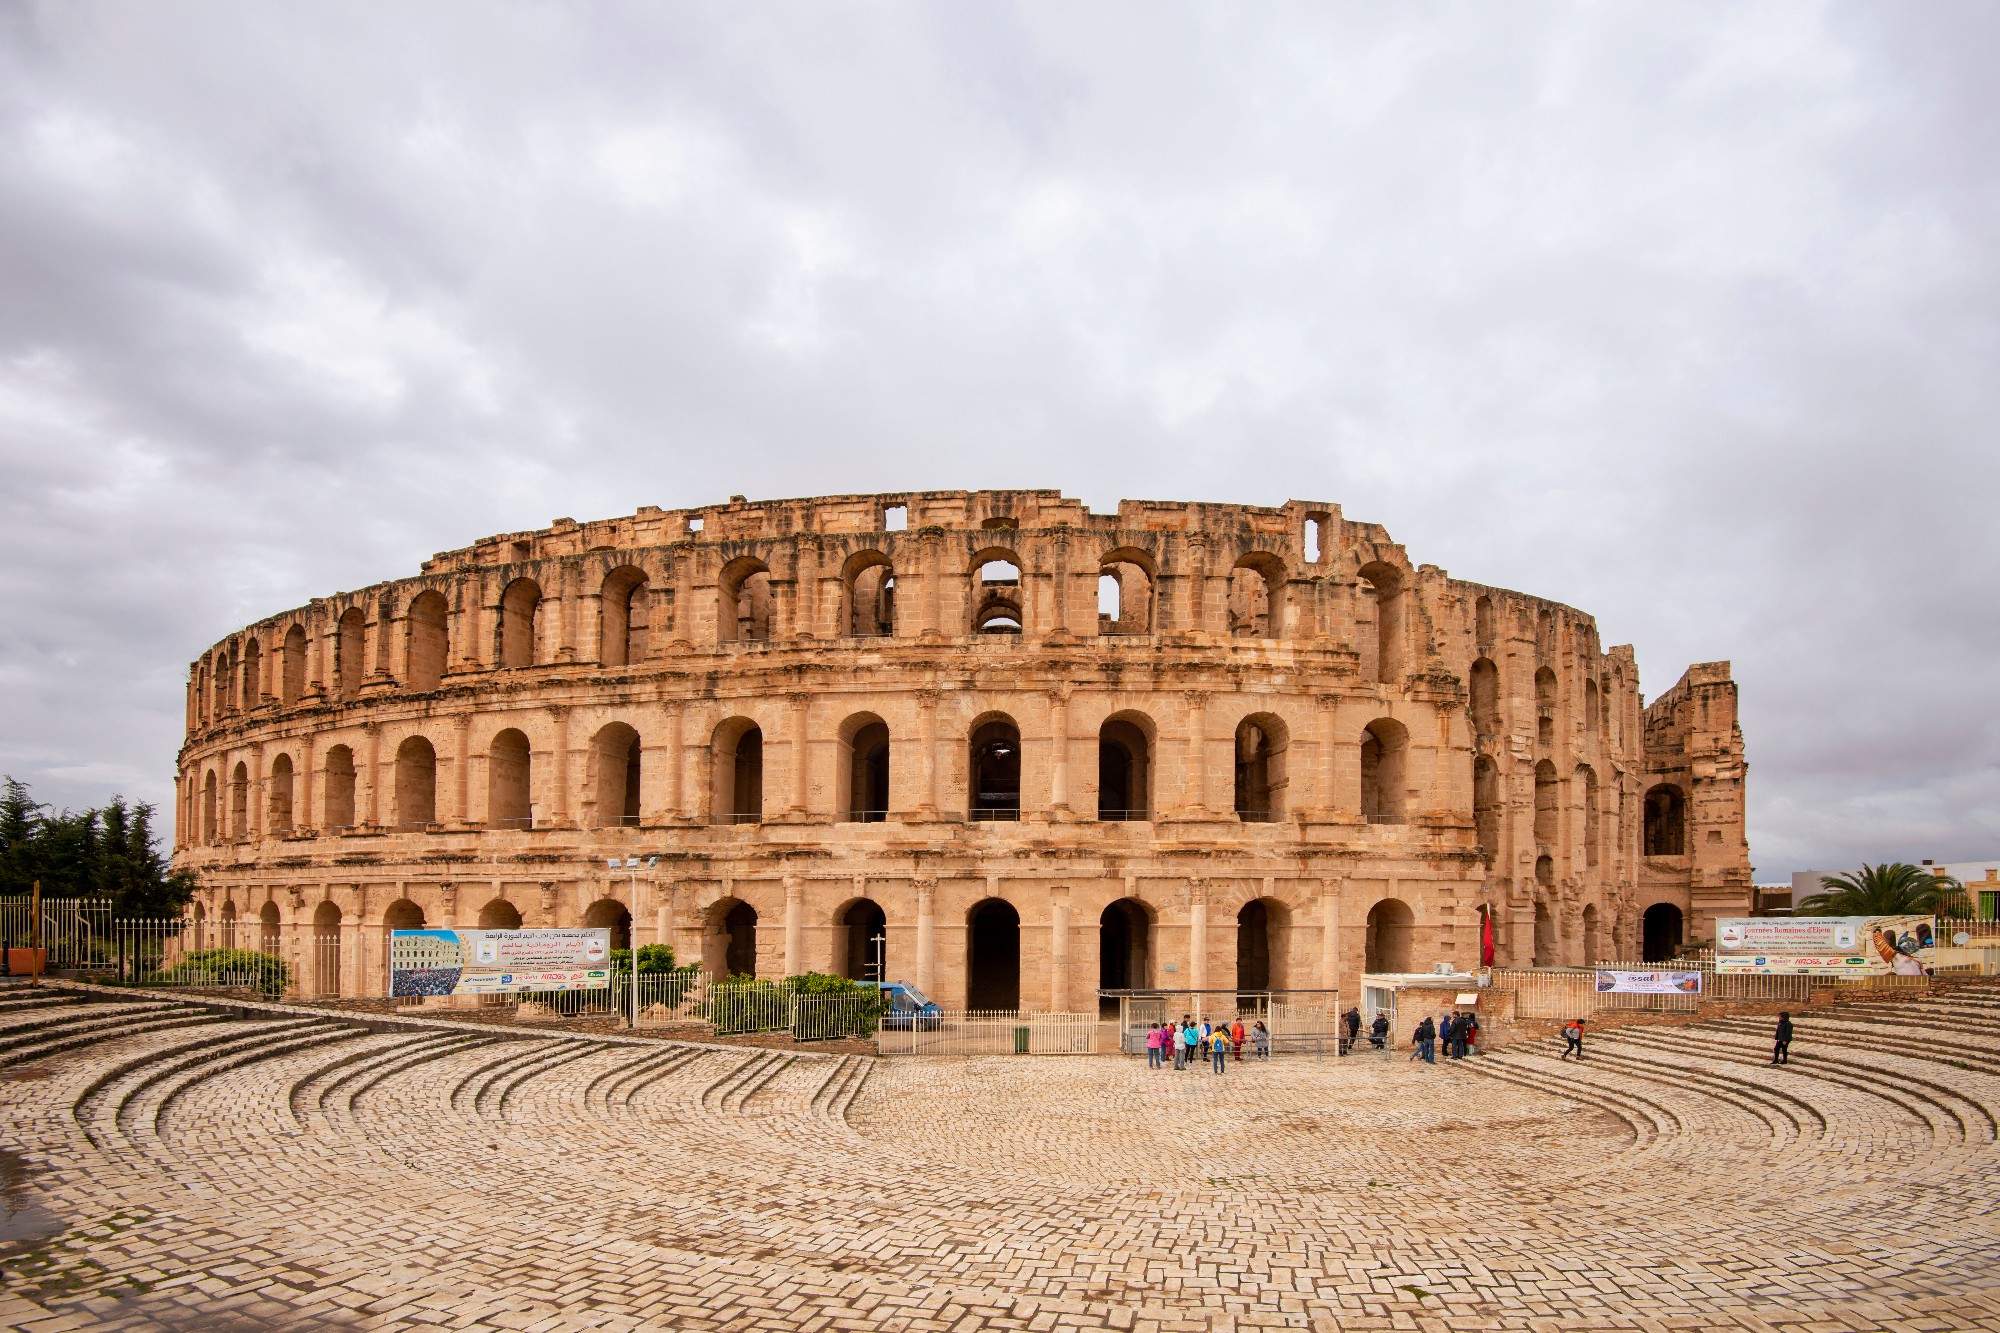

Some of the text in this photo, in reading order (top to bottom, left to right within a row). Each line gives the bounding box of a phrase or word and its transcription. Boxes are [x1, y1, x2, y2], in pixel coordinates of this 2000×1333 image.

[1744, 926, 1831, 935] Journées Romaines d'Eljem
